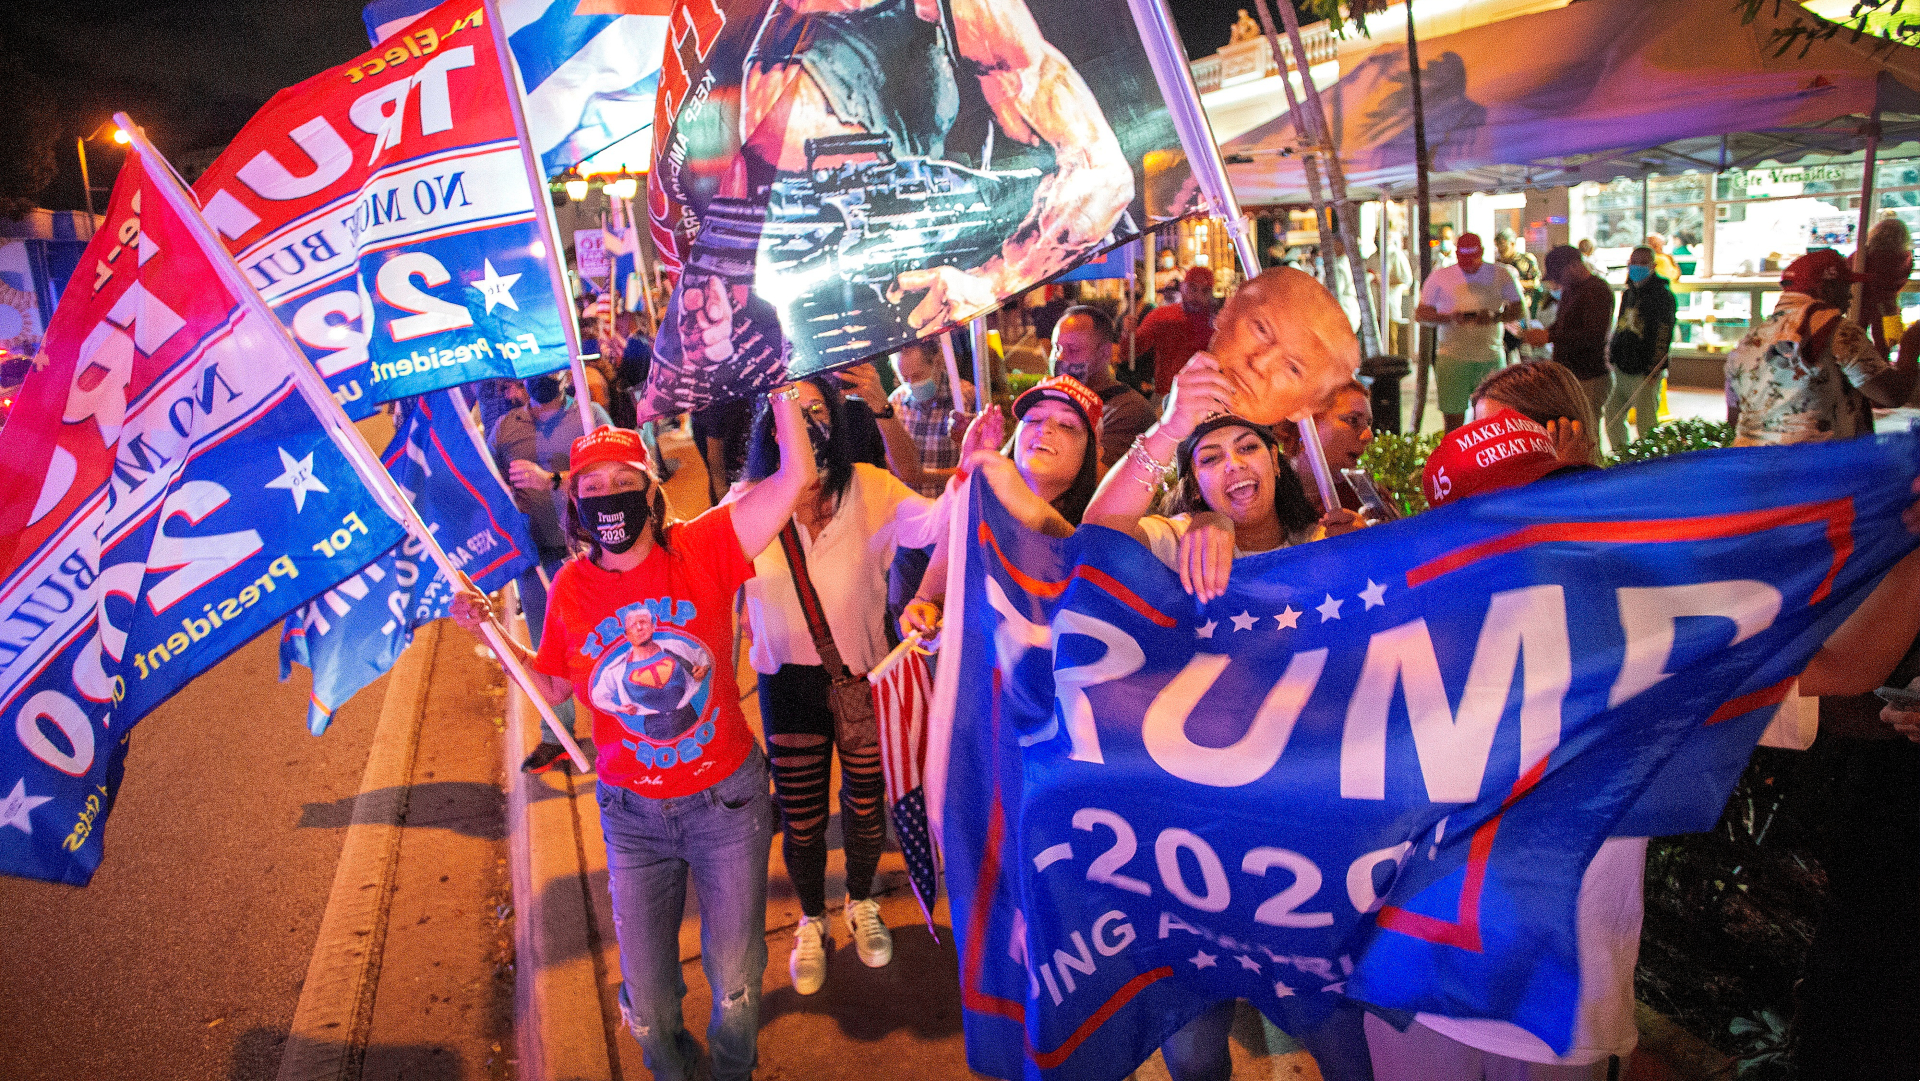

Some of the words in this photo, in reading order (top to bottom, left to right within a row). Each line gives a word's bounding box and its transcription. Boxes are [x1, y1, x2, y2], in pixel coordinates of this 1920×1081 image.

[1456, 421, 1505, 452] MAKE
[1475, 438, 1530, 467] GREAT
[1432, 465, 1451, 500] 45
[597, 511, 625, 523] Trump
[601, 528, 626, 541] 2020
